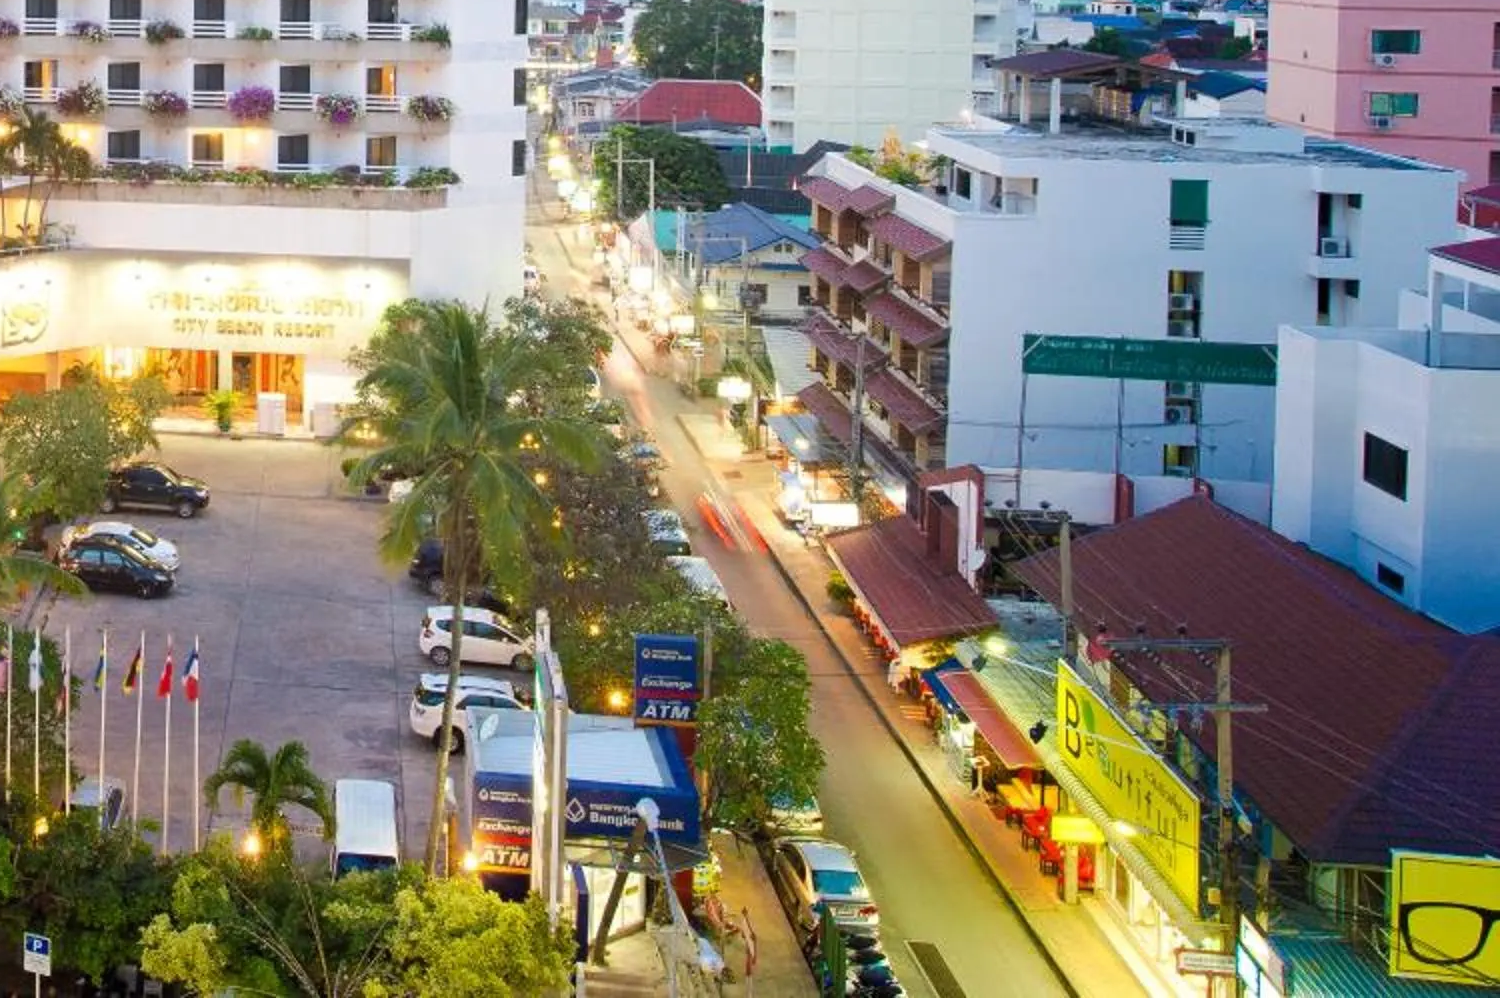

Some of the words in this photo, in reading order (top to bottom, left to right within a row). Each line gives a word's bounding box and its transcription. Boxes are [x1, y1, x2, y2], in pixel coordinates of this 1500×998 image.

[216, 318, 264, 336] BEACH
[273, 321, 336, 339] RESORT
[642, 677, 693, 691] Exchange
[643, 705, 691, 719] ATM
[590, 811, 638, 827] Bangko
[658, 818, 684, 831] ank
[479, 849, 529, 867] ATM
[33, 939, 43, 951] P
